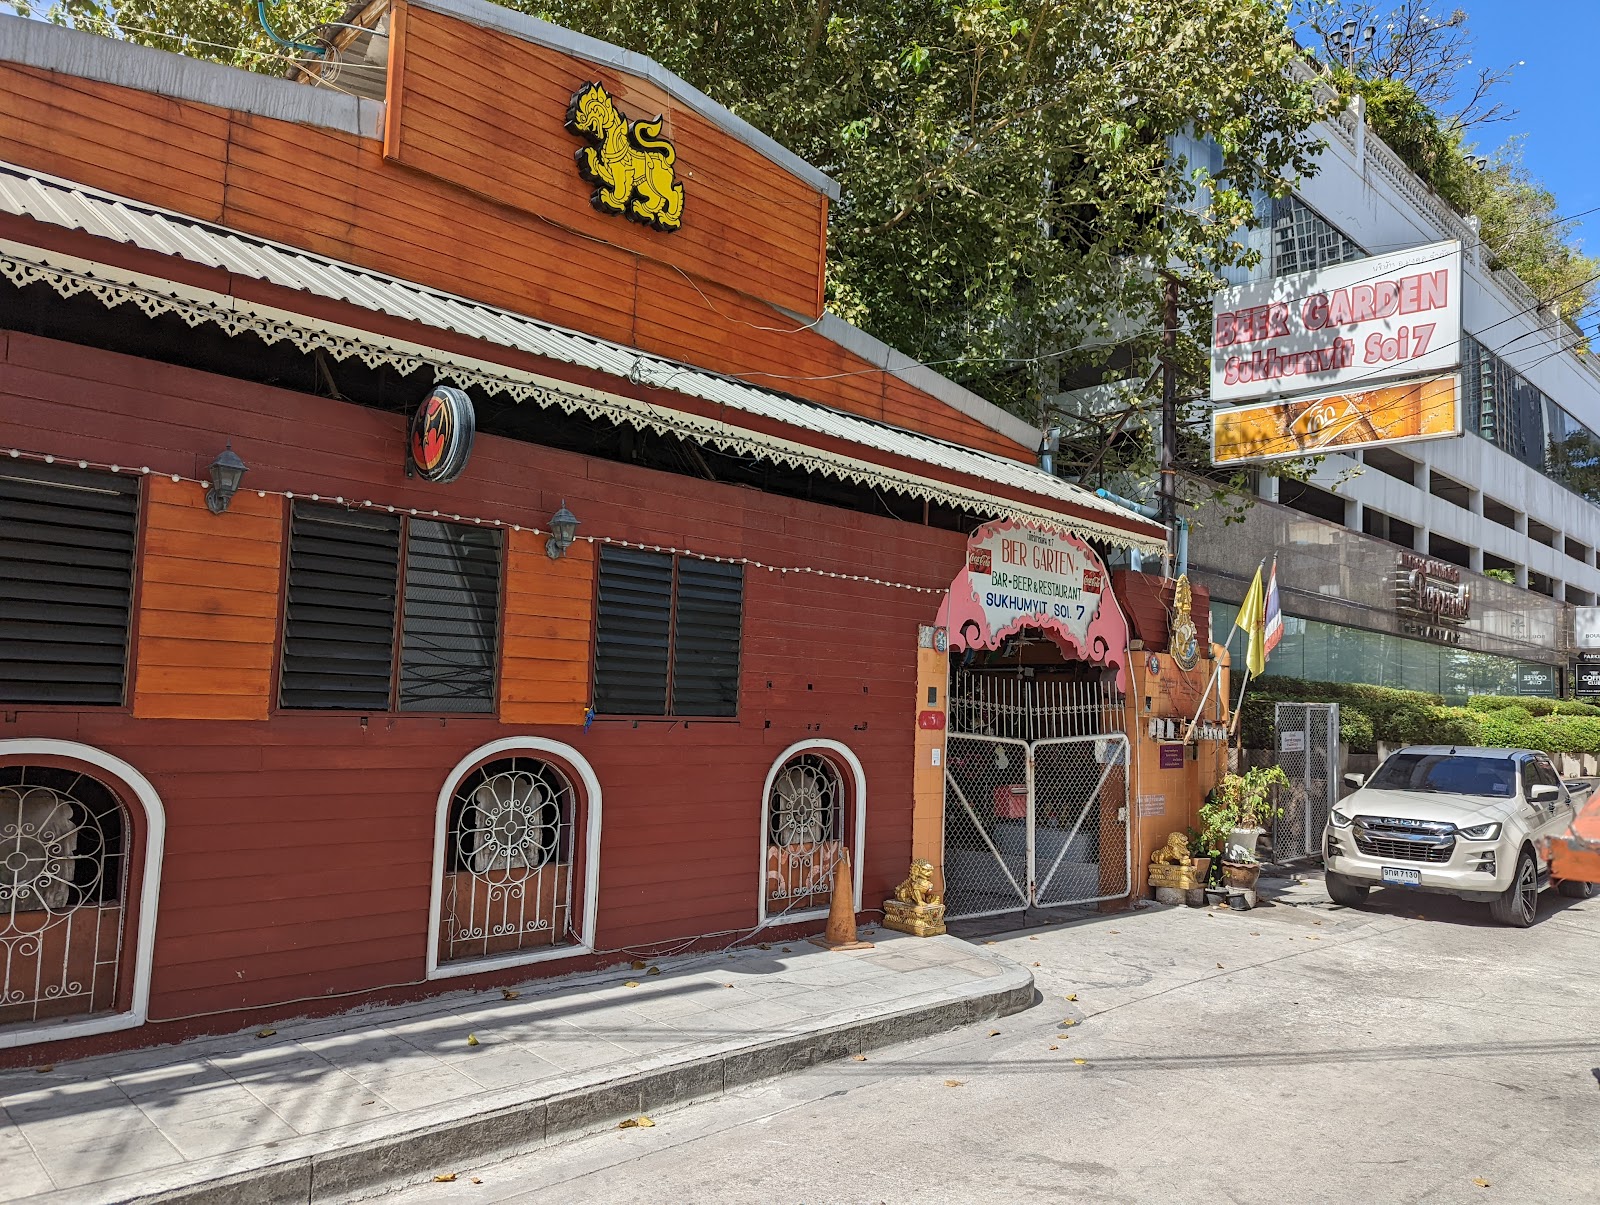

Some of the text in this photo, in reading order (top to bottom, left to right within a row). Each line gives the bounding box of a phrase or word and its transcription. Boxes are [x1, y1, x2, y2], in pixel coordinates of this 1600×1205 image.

[1216, 269, 1448, 347] BEER GARDEN
[1224, 323, 1436, 385] Sukhumvit Soi 7
[1001, 538, 1027, 567] BIER
[1076, 605, 1085, 620] 7
[1383, 818, 1420, 826] ISUZU
[1400, 870, 1417, 879] 7130
